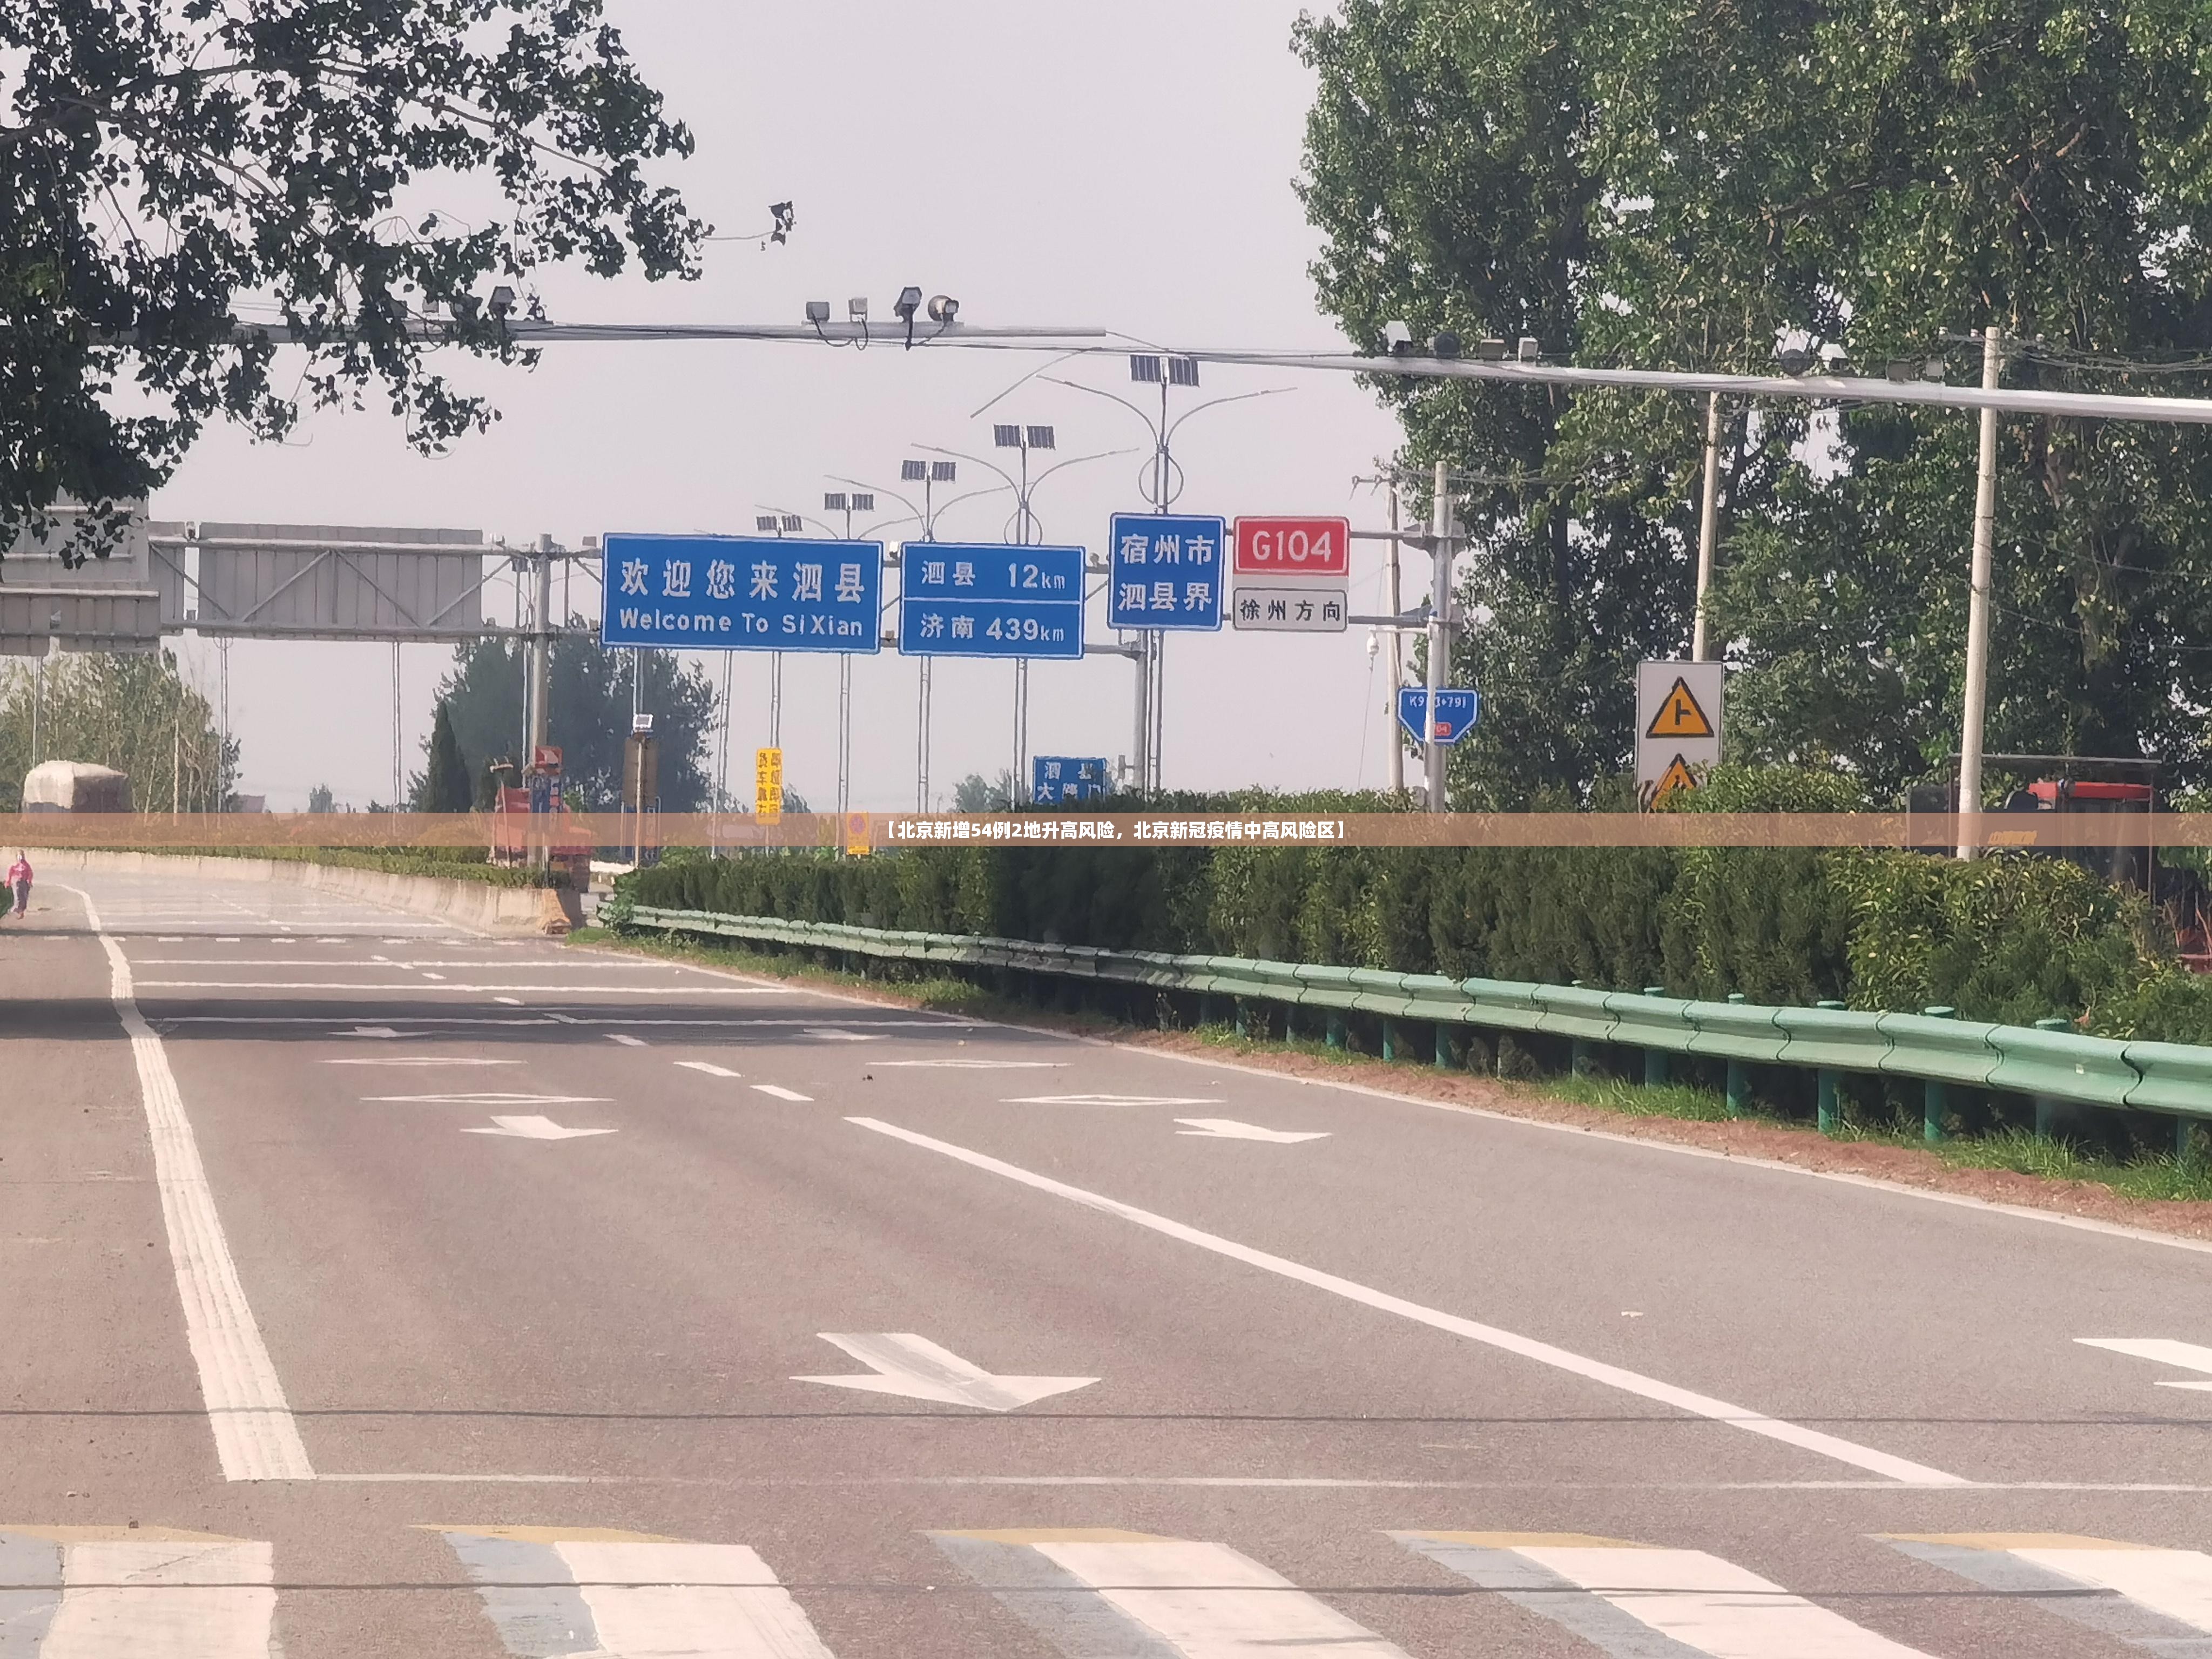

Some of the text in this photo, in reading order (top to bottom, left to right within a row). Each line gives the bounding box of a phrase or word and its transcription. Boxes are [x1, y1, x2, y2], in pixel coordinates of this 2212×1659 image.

[1120, 534, 1214, 565] 宿州市
[1252, 530, 1332, 563] G104
[619, 558, 865, 603] 欢迎您来泗县
[921, 560, 1065, 590] 泗县 12km
[1117, 582, 1212, 612] 泗县界
[1240, 598, 1340, 622] 徐州方向
[619, 608, 862, 637] Welcome To SiXian
[920, 612, 1064, 642] 济南 439km
